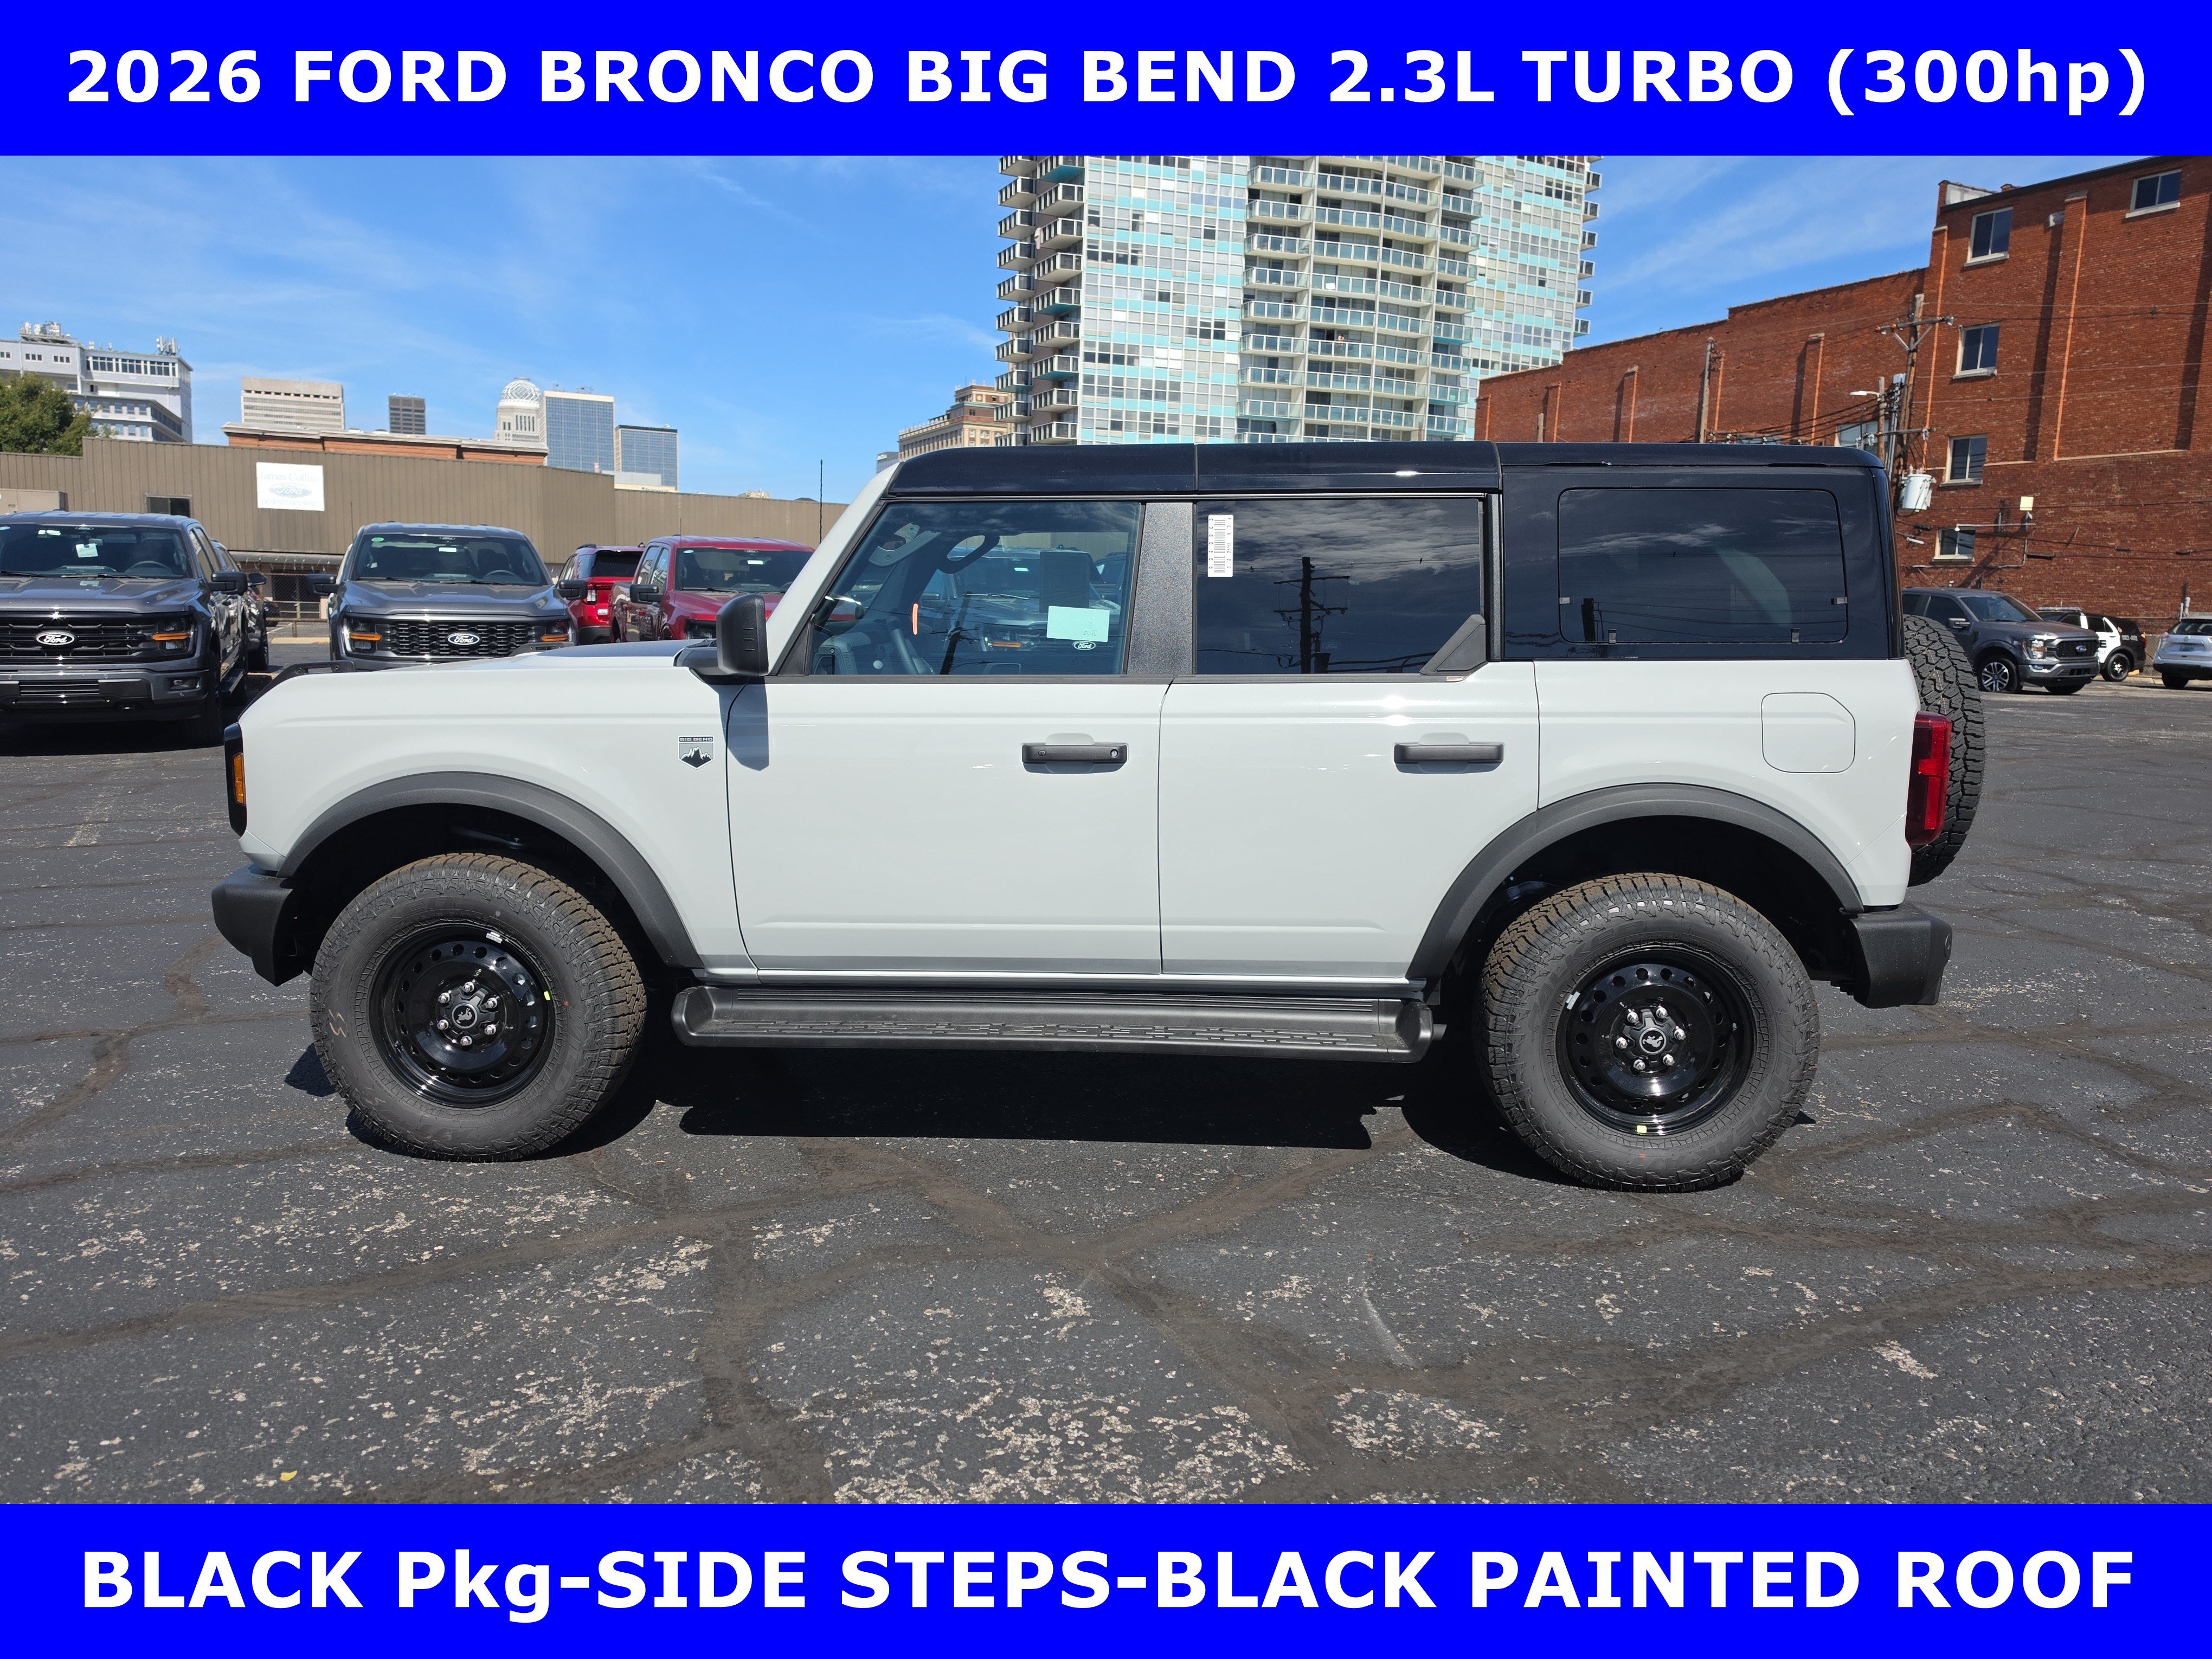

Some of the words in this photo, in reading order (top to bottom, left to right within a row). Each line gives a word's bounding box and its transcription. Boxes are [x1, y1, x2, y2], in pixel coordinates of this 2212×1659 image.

[260, 471, 286, 480] James
[288, 472, 320, 482] Collins
[276, 484, 305, 495] Ford
[43, 634, 67, 643] Ford
[453, 635, 474, 643] Ford
